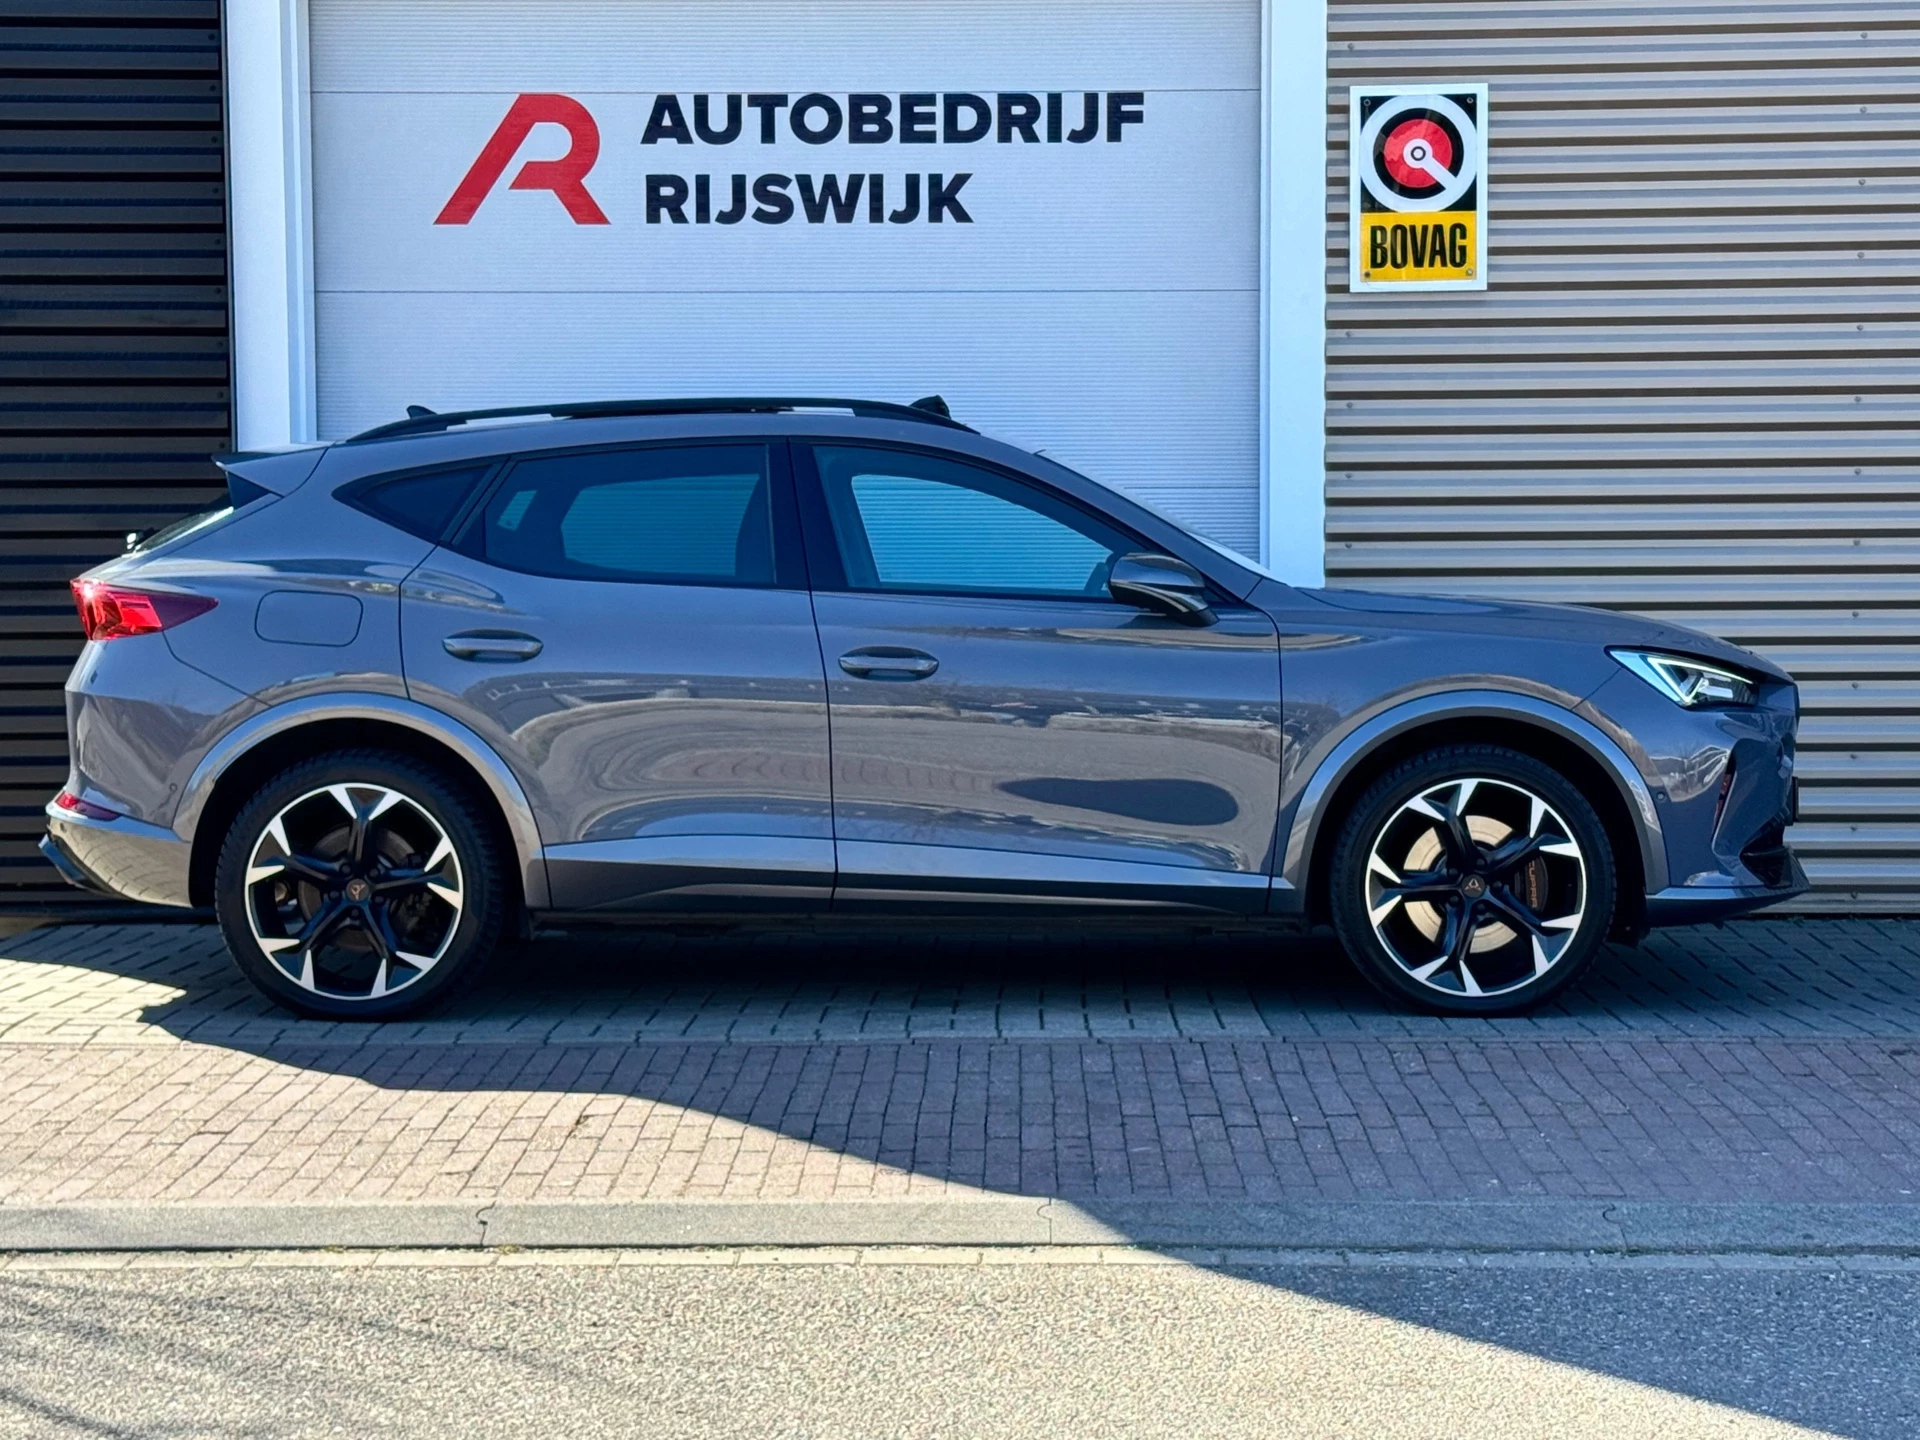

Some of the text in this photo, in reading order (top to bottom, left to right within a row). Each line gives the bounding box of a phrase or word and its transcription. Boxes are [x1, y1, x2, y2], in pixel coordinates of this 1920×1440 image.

[641, 92, 1145, 145] AUTOBEDRIJF
[645, 173, 974, 225] RIJSWIJK
[1370, 222, 1468, 269] BOVAG
